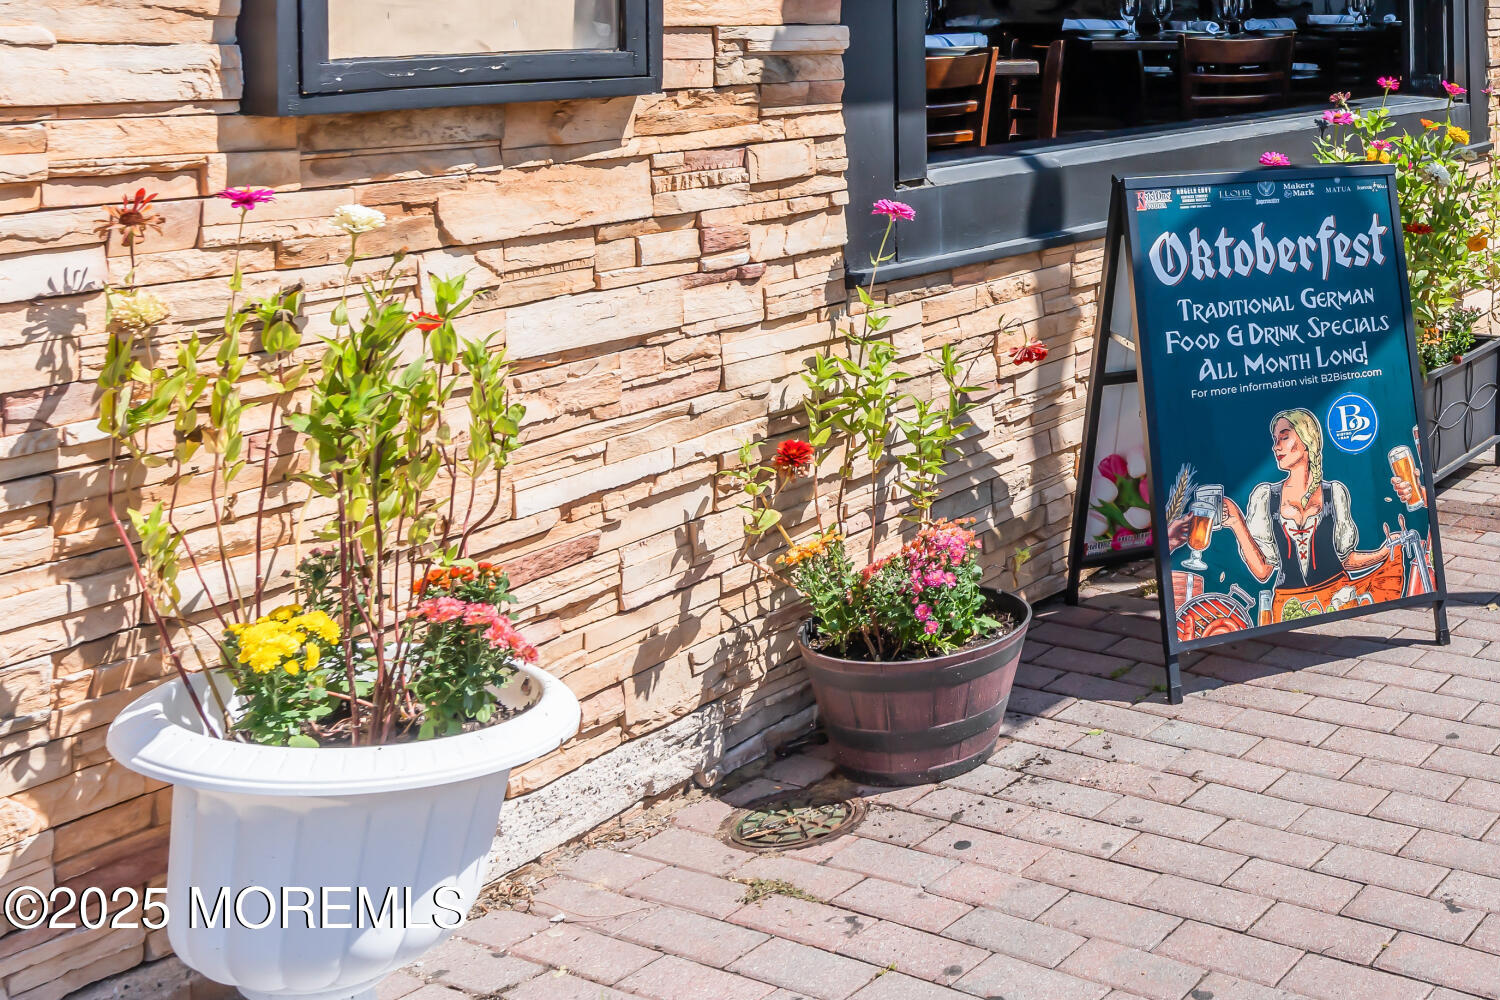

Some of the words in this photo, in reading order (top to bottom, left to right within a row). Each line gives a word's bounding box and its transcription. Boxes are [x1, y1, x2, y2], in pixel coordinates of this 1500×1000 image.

[1283, 182, 1315, 190] Maker's
[1292, 189, 1315, 197] Mark
[1149, 213, 1388, 286] Oktoberfest
[1177, 296, 1295, 323] TRADITIONAL
[1300, 288, 1375, 310] GERMAN
[1165, 331, 1220, 354] FOOD
[1227, 325, 1243, 346] &
[1248, 323, 1305, 346] DRINK
[1307, 315, 1390, 338] SPECIALS
[1199, 358, 1238, 381] ALL
[1243, 353, 1311, 376] MONTH
[1316, 340, 1368, 366] LONG!
[1191, 389, 1208, 399] For
[1210, 386, 1237, 396] more
[1239, 379, 1297, 393] information
[1299, 375, 1319, 385] visit
[1321, 368, 1383, 383] B2Bistro.com
[1336, 404, 1372, 442] B2
